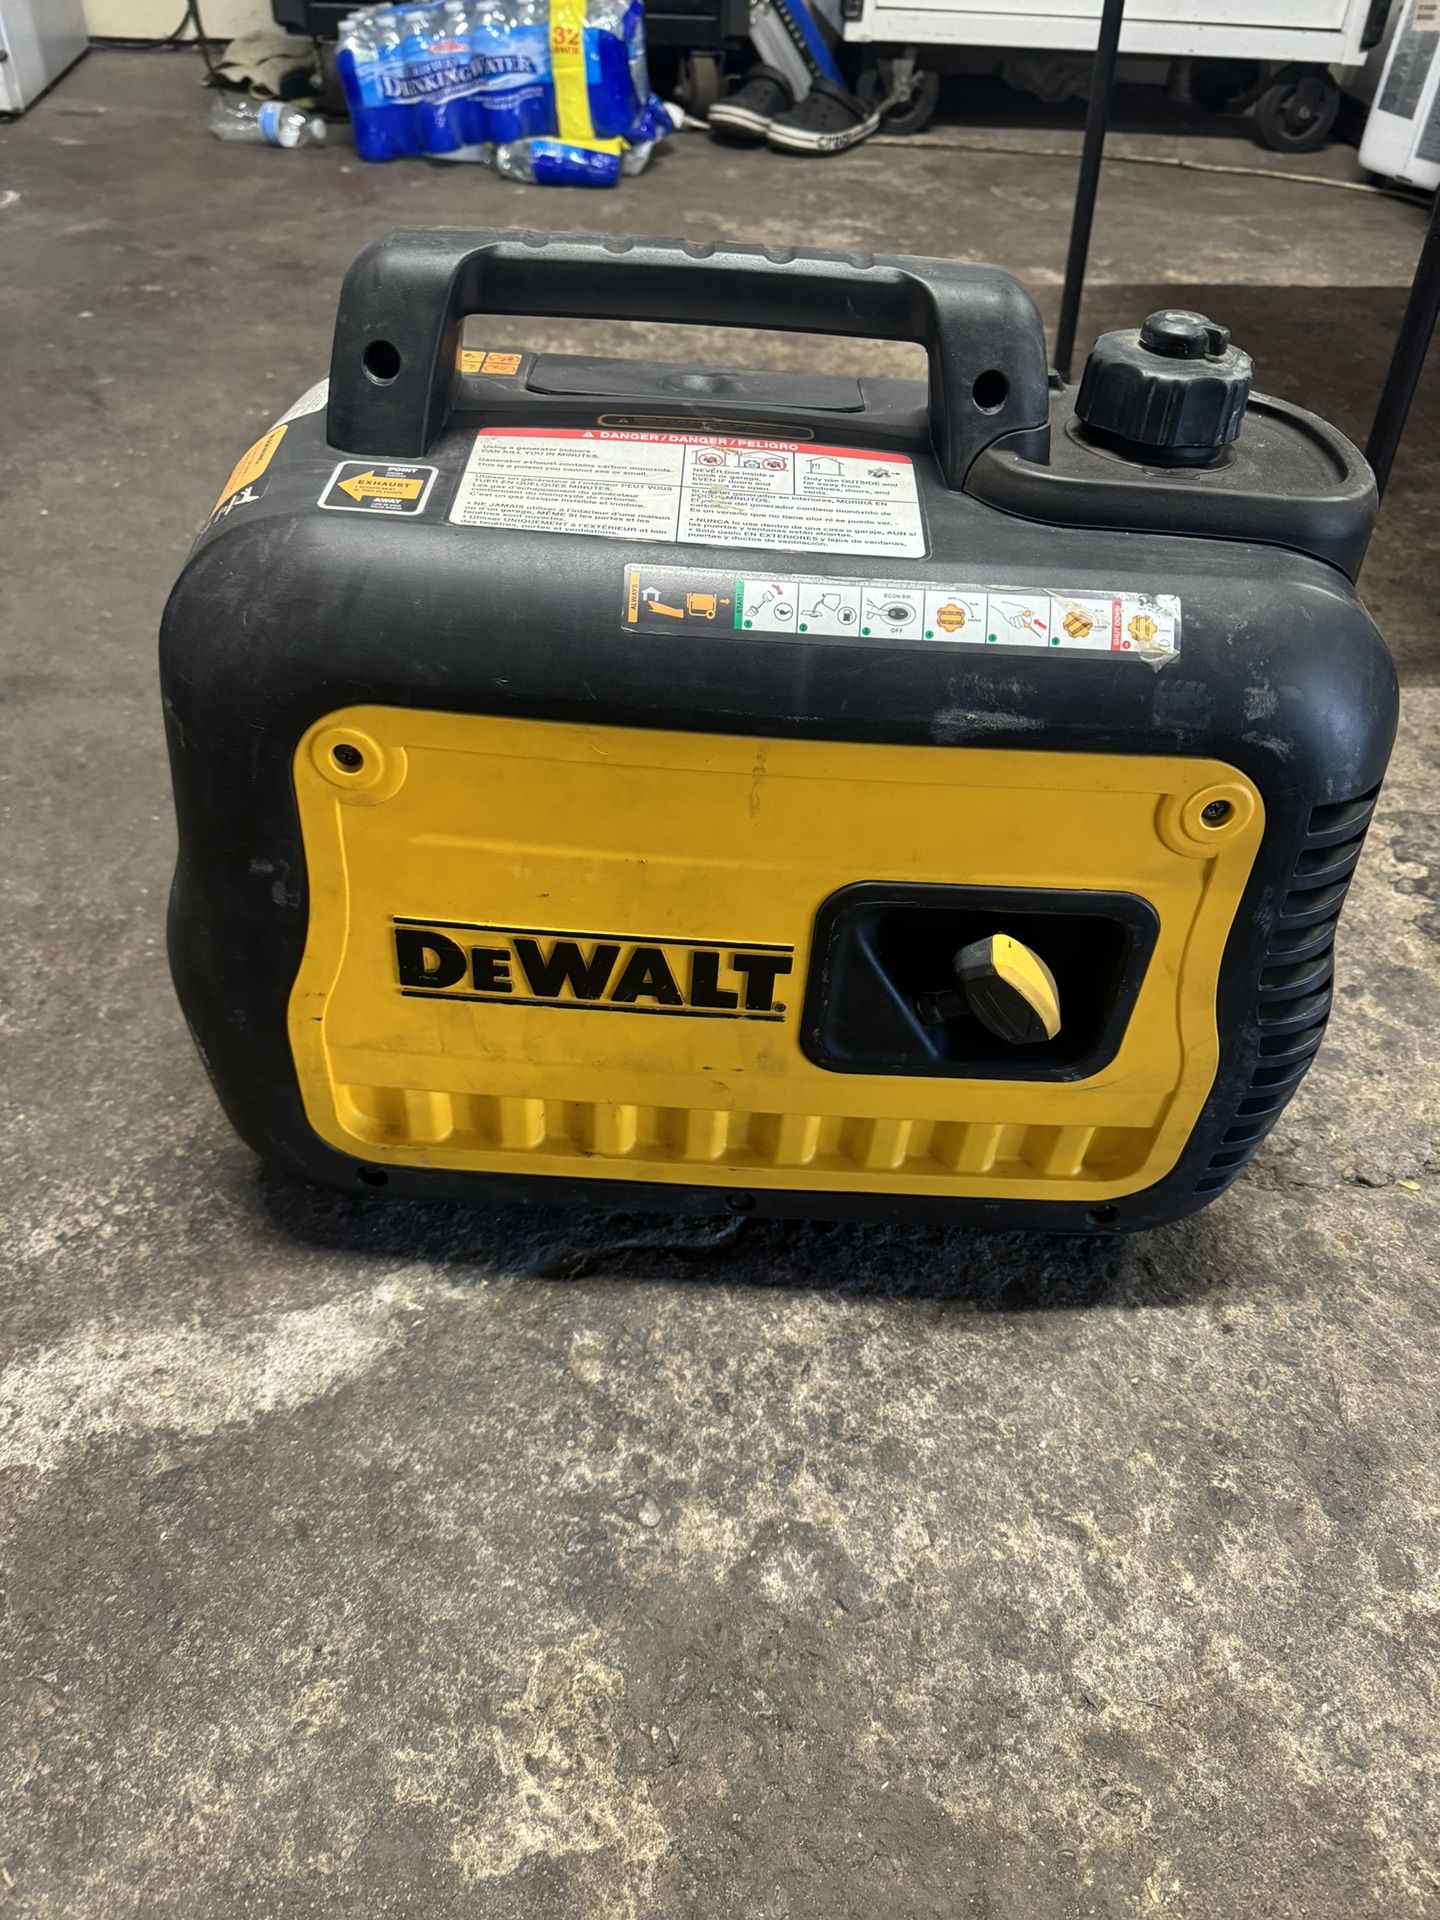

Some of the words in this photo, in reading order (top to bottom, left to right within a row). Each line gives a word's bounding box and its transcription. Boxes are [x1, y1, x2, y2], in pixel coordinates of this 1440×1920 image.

[554, 27, 578, 45] 32
[468, 54, 533, 77] WATER
[600, 431, 659, 440] DANGER
[669, 435, 727, 445] DANGER
[738, 439, 799, 450] PELIGRO
[358, 480, 412, 488] EXHAUST
[1112, 606, 1120, 626] DOWN
[1112, 627, 1120, 646] SHUT
[394, 928, 792, 1011] DEWALT
